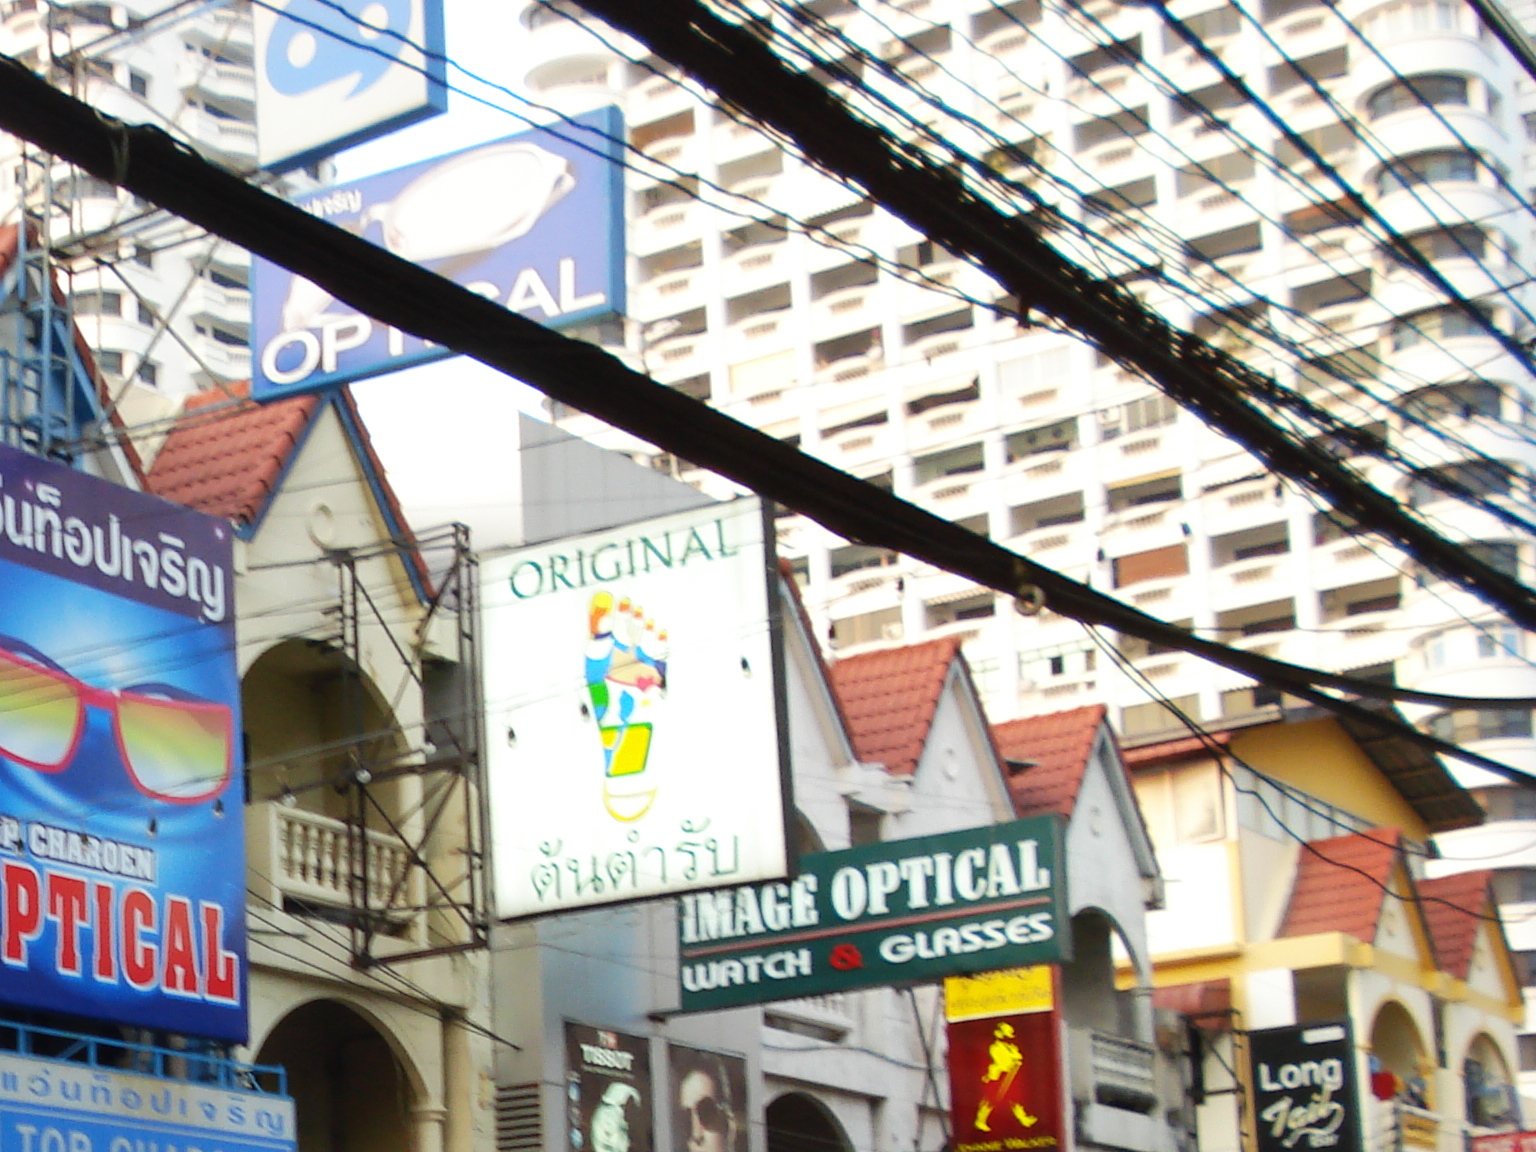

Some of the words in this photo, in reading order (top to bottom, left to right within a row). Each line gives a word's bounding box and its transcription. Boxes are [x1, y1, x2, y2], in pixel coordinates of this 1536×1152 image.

[261, 257, 606, 384] OPAL
[509, 518, 740, 600] ORIGINAL
[29, 822, 156, 882] CHAROEN
[530, 816, 739, 902] ต้นตำรับ
[680, 873, 819, 943] IMAGE
[831, 839, 1052, 921] OPTICAL
[682, 948, 813, 992] WATCH
[829, 943, 863, 971] &
[879, 912, 1056, 964] GLASSES
[0, 1066, 285, 1137] แว่นท็อปเจริญ
[1258, 1058, 1343, 1092] Long
